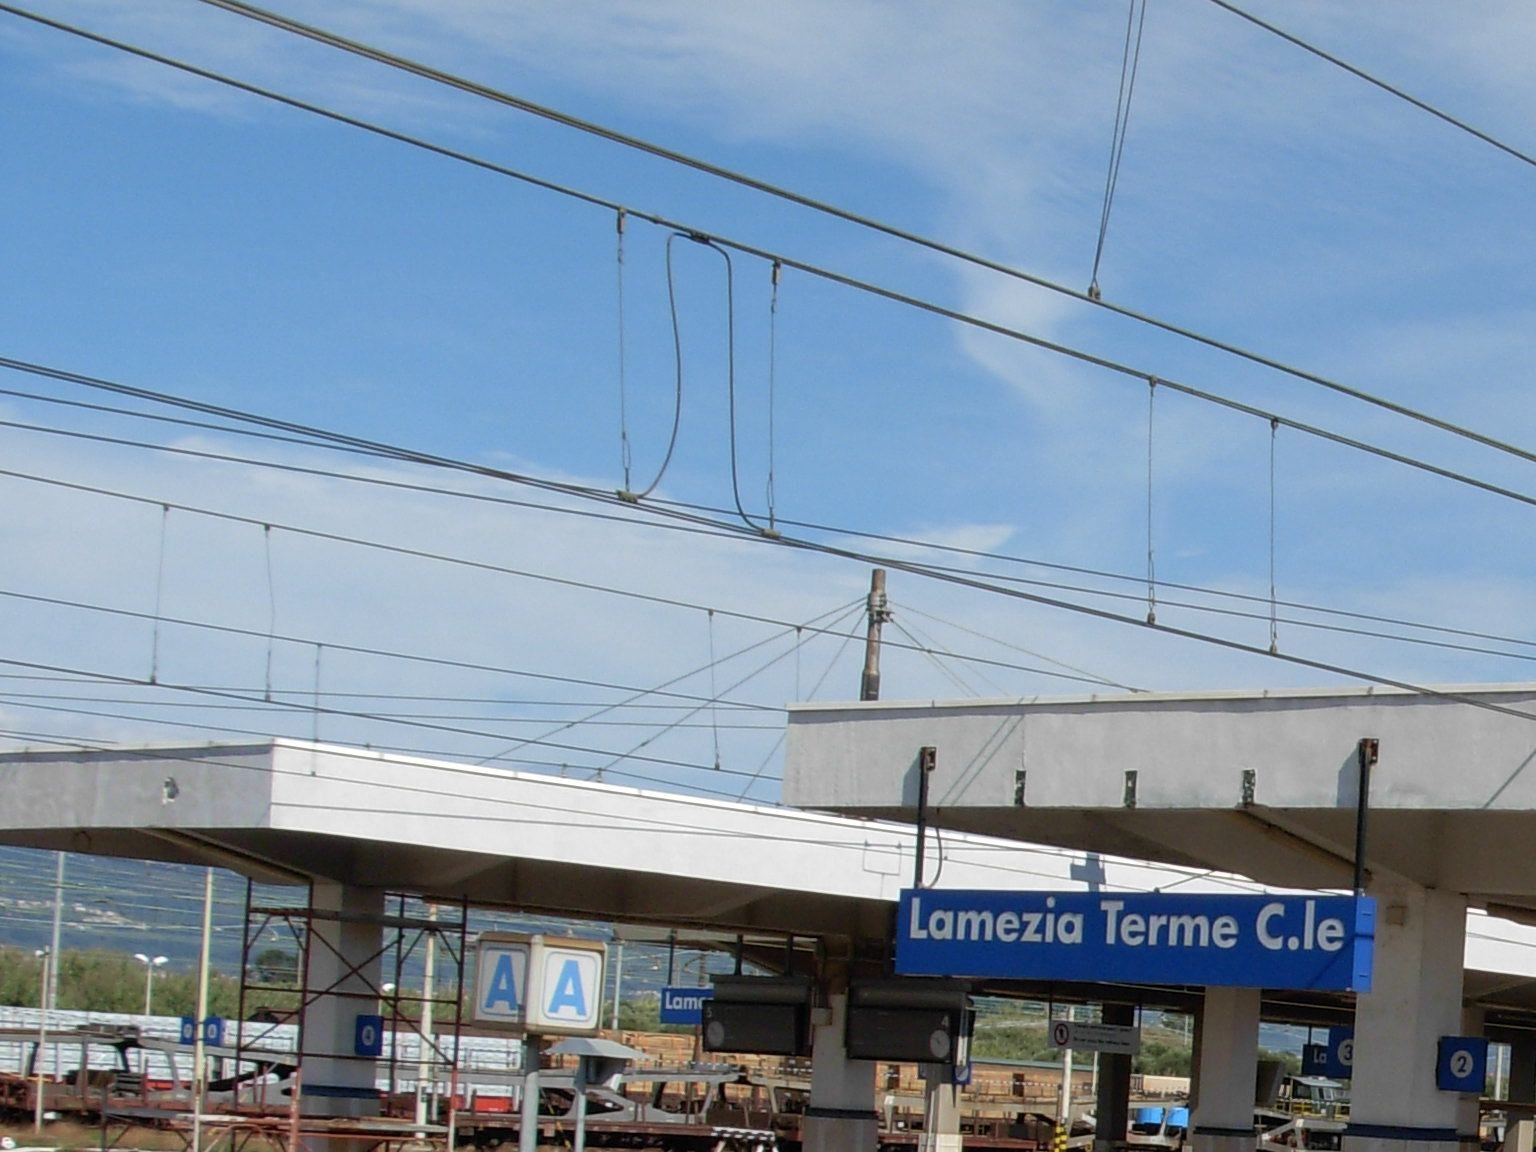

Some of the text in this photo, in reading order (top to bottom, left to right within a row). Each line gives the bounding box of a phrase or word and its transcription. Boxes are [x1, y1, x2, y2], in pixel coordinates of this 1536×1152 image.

[909, 896, 1346, 951] Lamezia Terme C.le
[485, 954, 519, 1010] A
[547, 959, 587, 1016] A
[1343, 1044, 1353, 1060] 3
[1457, 1056, 1467, 1073] 2
